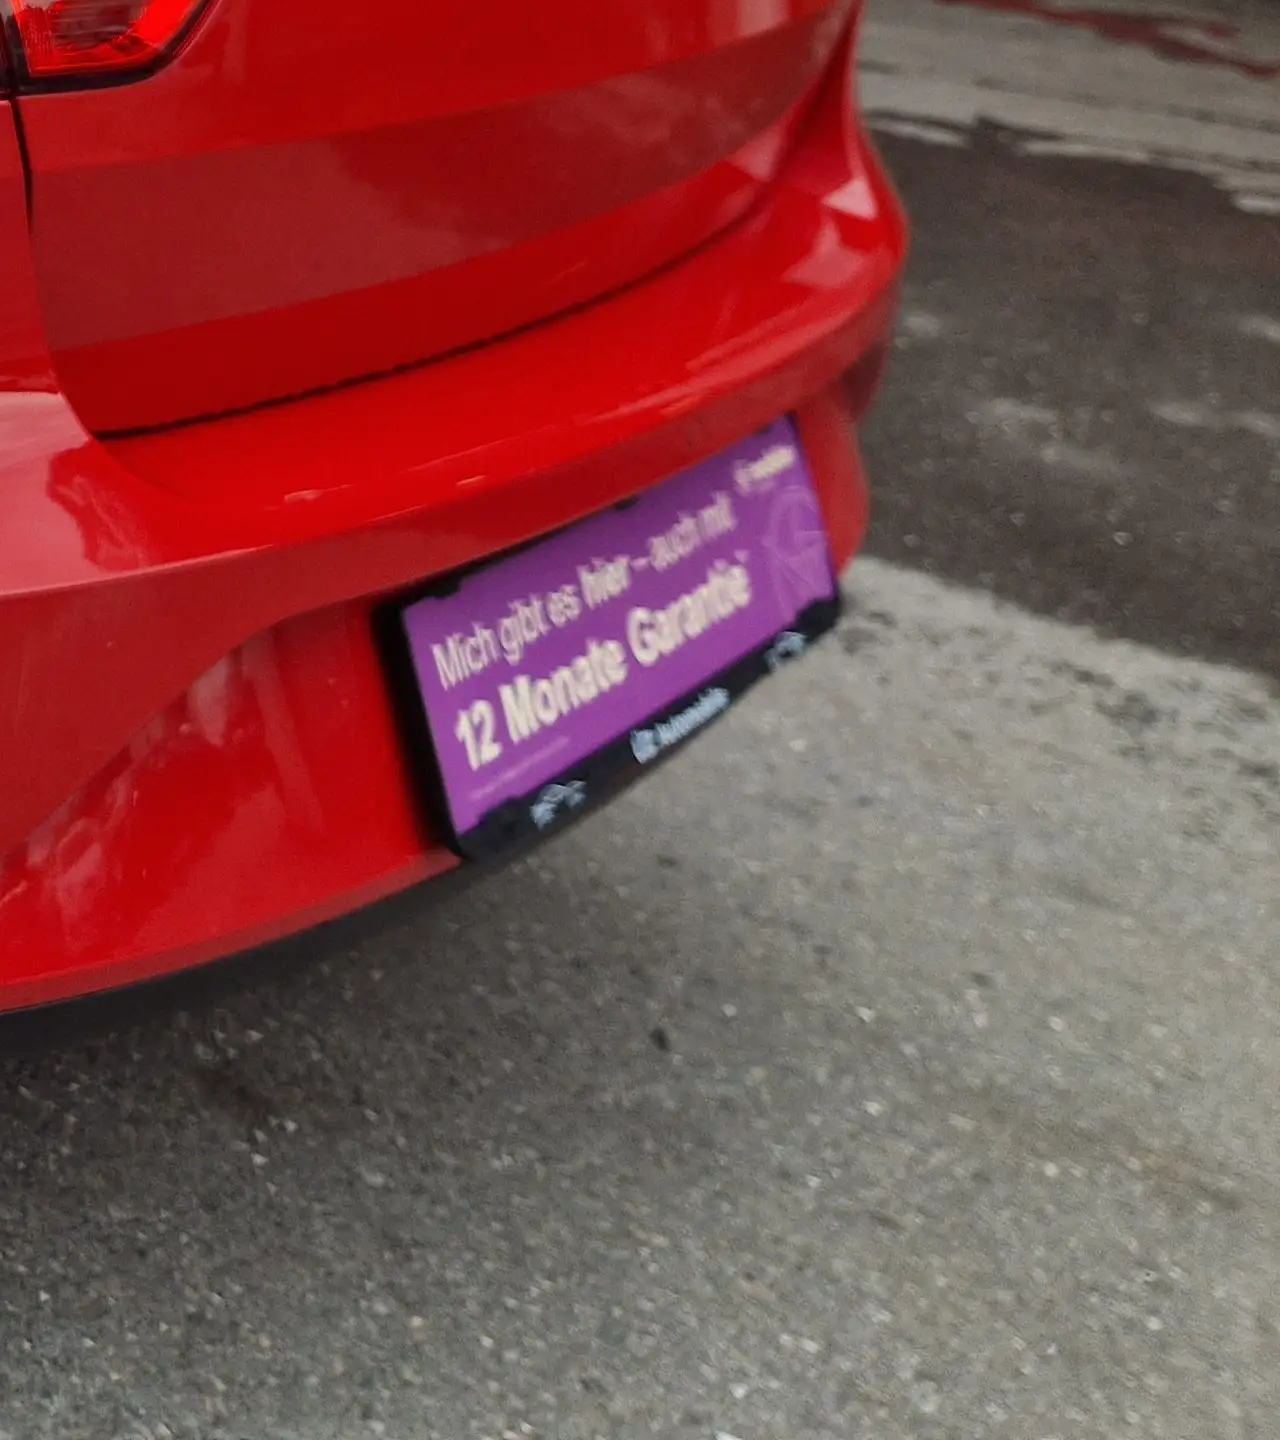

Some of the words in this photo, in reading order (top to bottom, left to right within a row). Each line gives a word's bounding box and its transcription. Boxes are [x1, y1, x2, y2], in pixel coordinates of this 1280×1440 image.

[431, 621, 500, 692] Mich
[498, 593, 550, 666] gibt
[546, 583, 583, 628] es
[577, 554, 631, 610] hier
[648, 510, 702, 572] auch
[454, 698, 503, 772] 12
[498, 636, 628, 745] Monate
